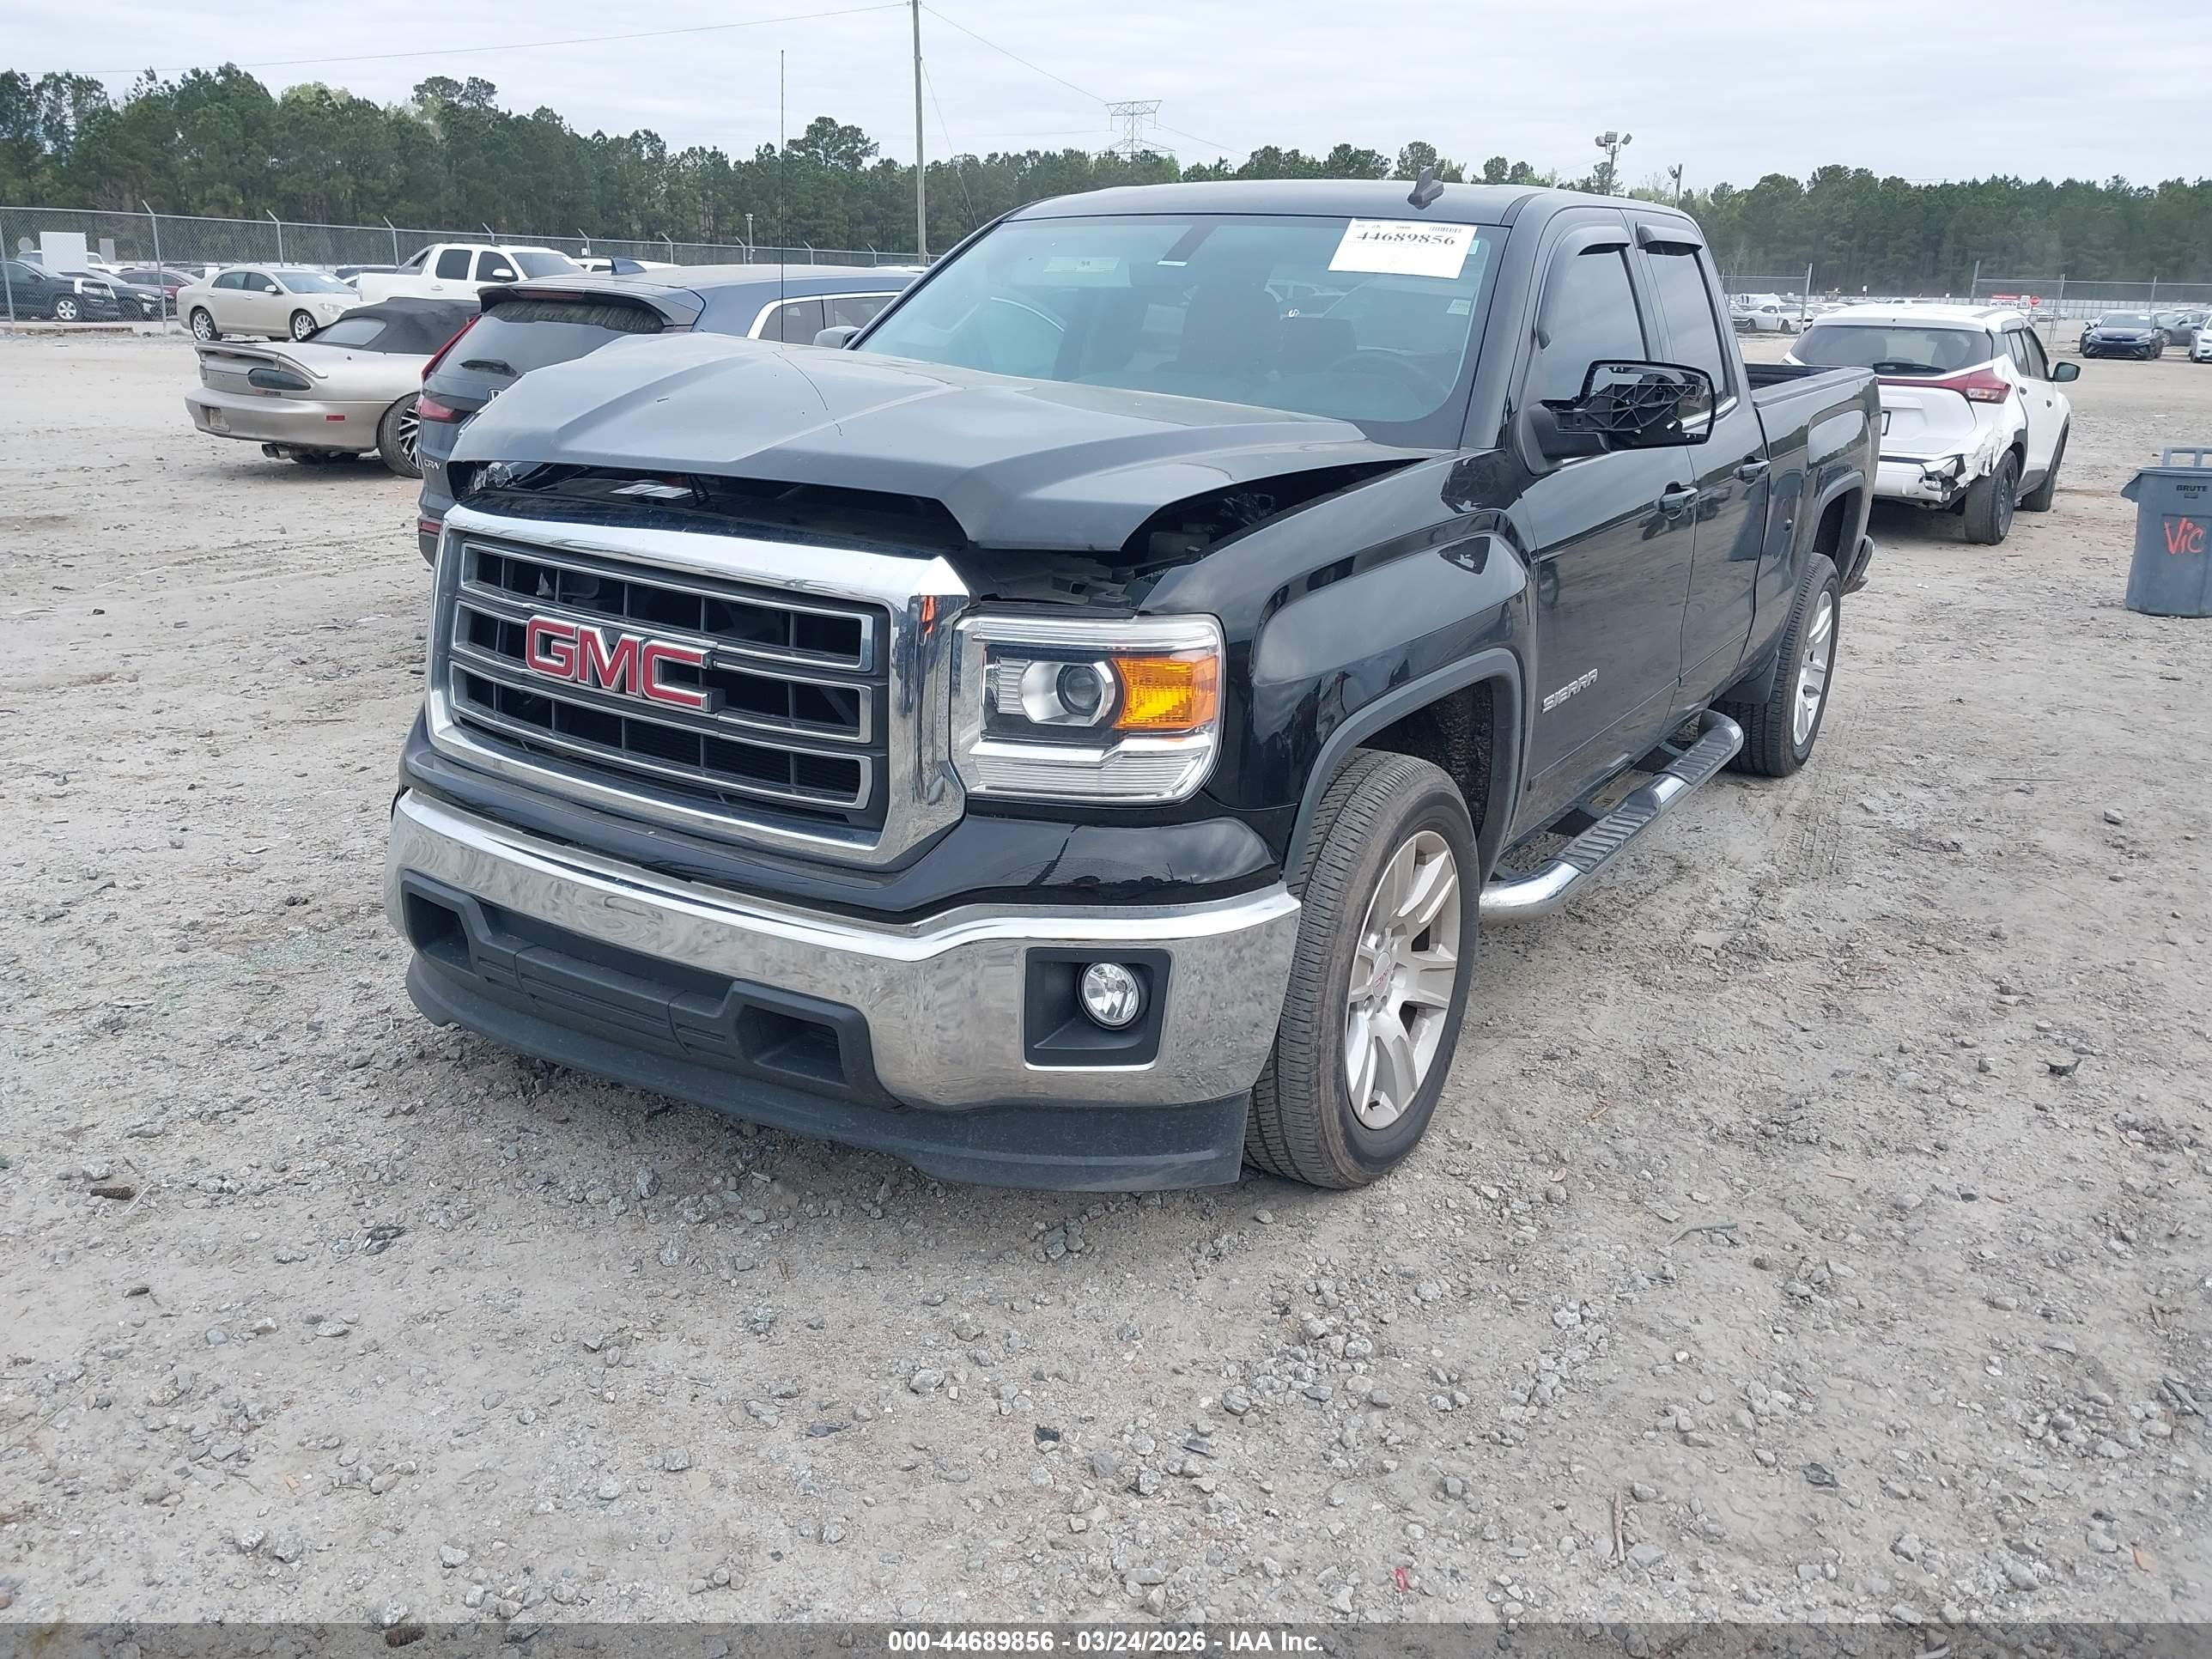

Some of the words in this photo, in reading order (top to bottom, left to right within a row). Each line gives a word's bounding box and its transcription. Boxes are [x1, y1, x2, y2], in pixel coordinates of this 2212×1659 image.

[1356, 232, 1455, 246] 44689856
[526, 615, 712, 713] GMC
[1542, 668, 1598, 714] SIERRA
